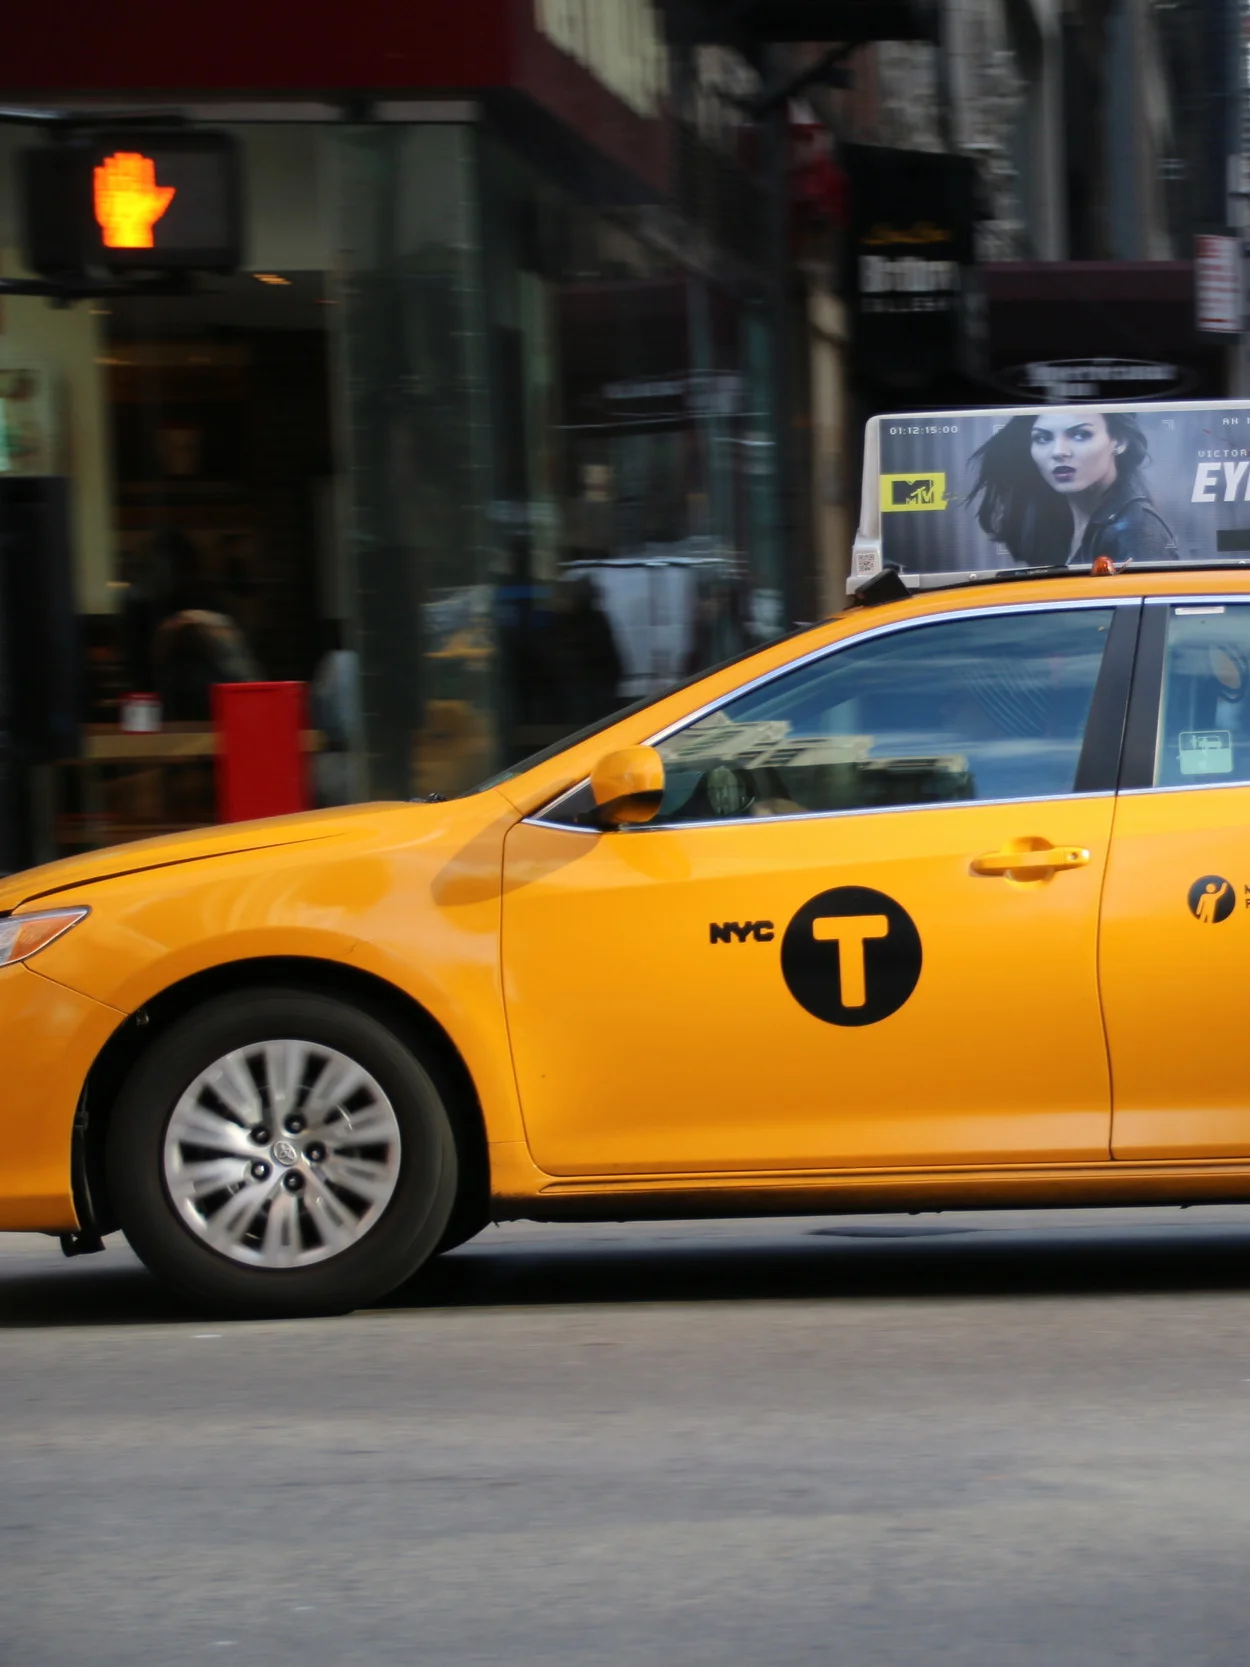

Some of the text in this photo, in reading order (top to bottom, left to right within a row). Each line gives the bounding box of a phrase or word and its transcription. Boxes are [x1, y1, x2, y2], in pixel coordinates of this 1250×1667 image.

[889, 425, 959, 435] 01:12:15:00
[1222, 417, 1239, 426] AN
[891, 479, 935, 506] MTV
[709, 914, 890, 1008] NYC T
